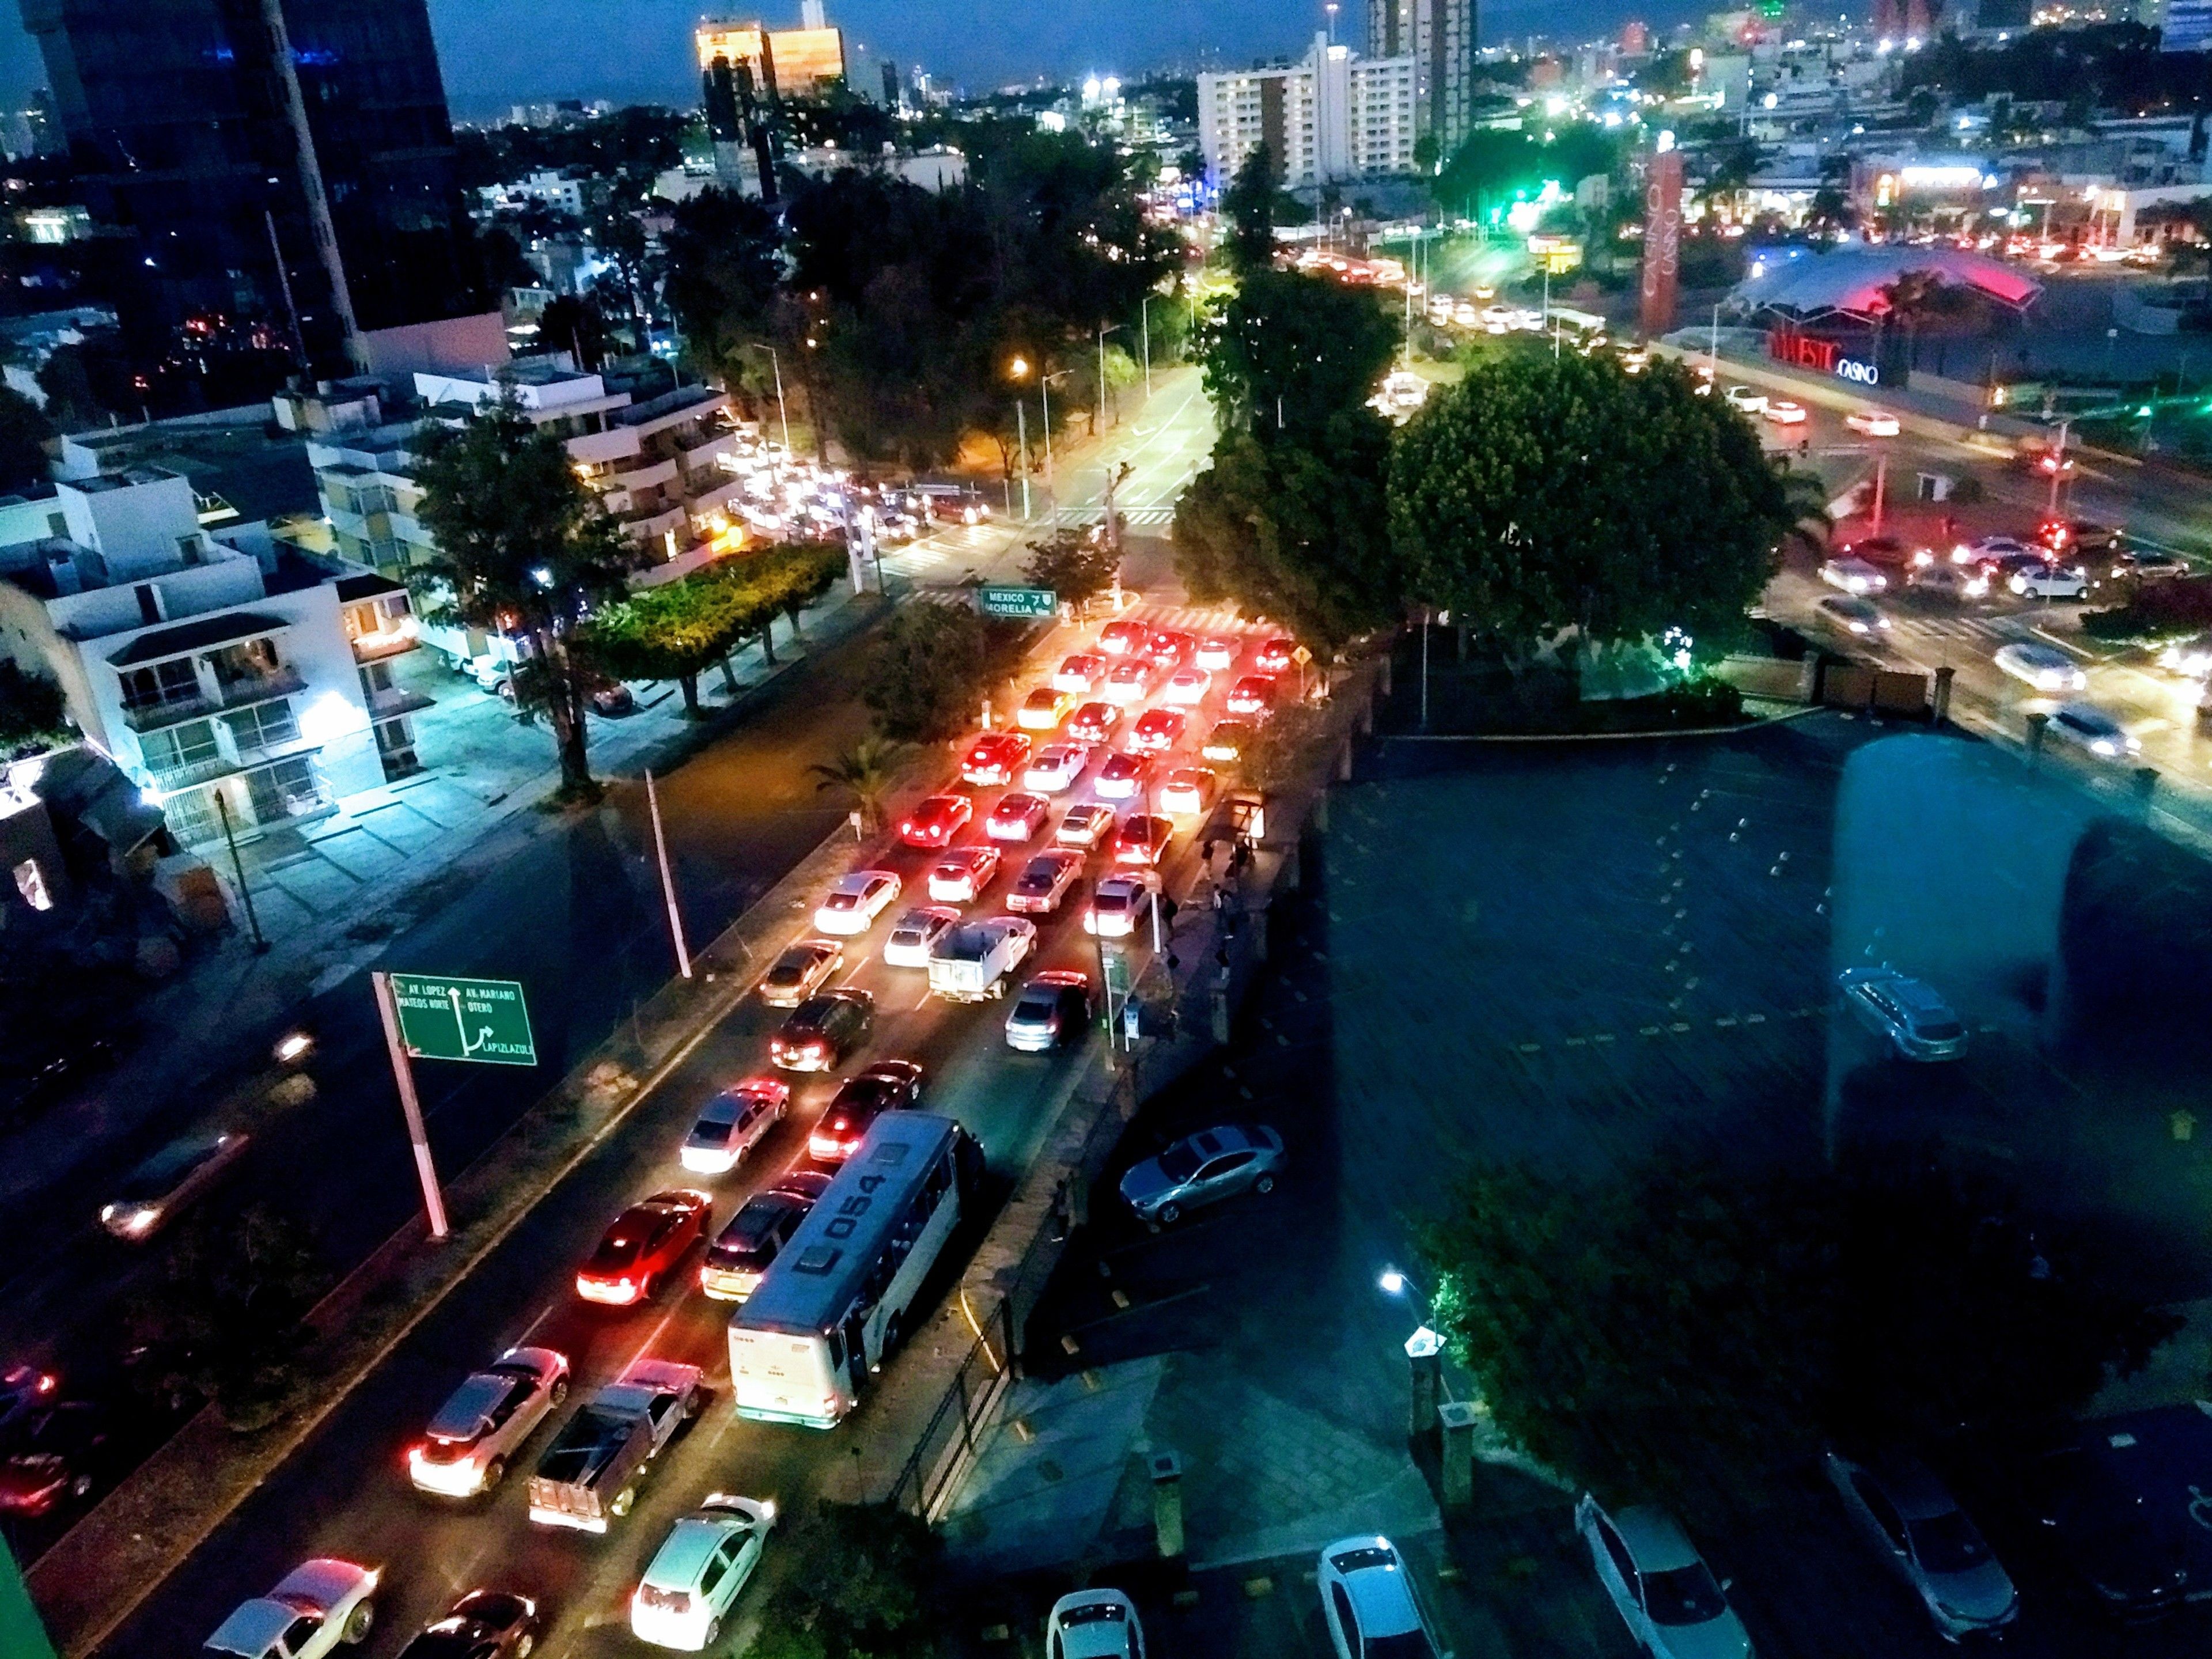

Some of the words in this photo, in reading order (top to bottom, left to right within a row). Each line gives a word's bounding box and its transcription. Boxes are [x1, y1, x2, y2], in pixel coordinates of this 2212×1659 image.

[1836, 358, 1879, 385] CASINO
[989, 592, 1025, 603] MEXICO
[986, 603, 1032, 614] MORELIA
[422, 985, 446, 997] LOPEZ
[479, 988, 516, 1001] MARIANO
[398, 997, 428, 1009] MATEOS
[429, 998, 450, 1010] NORTE
[467, 1001, 493, 1014] OTERO
[824, 1175, 887, 1239] 054
